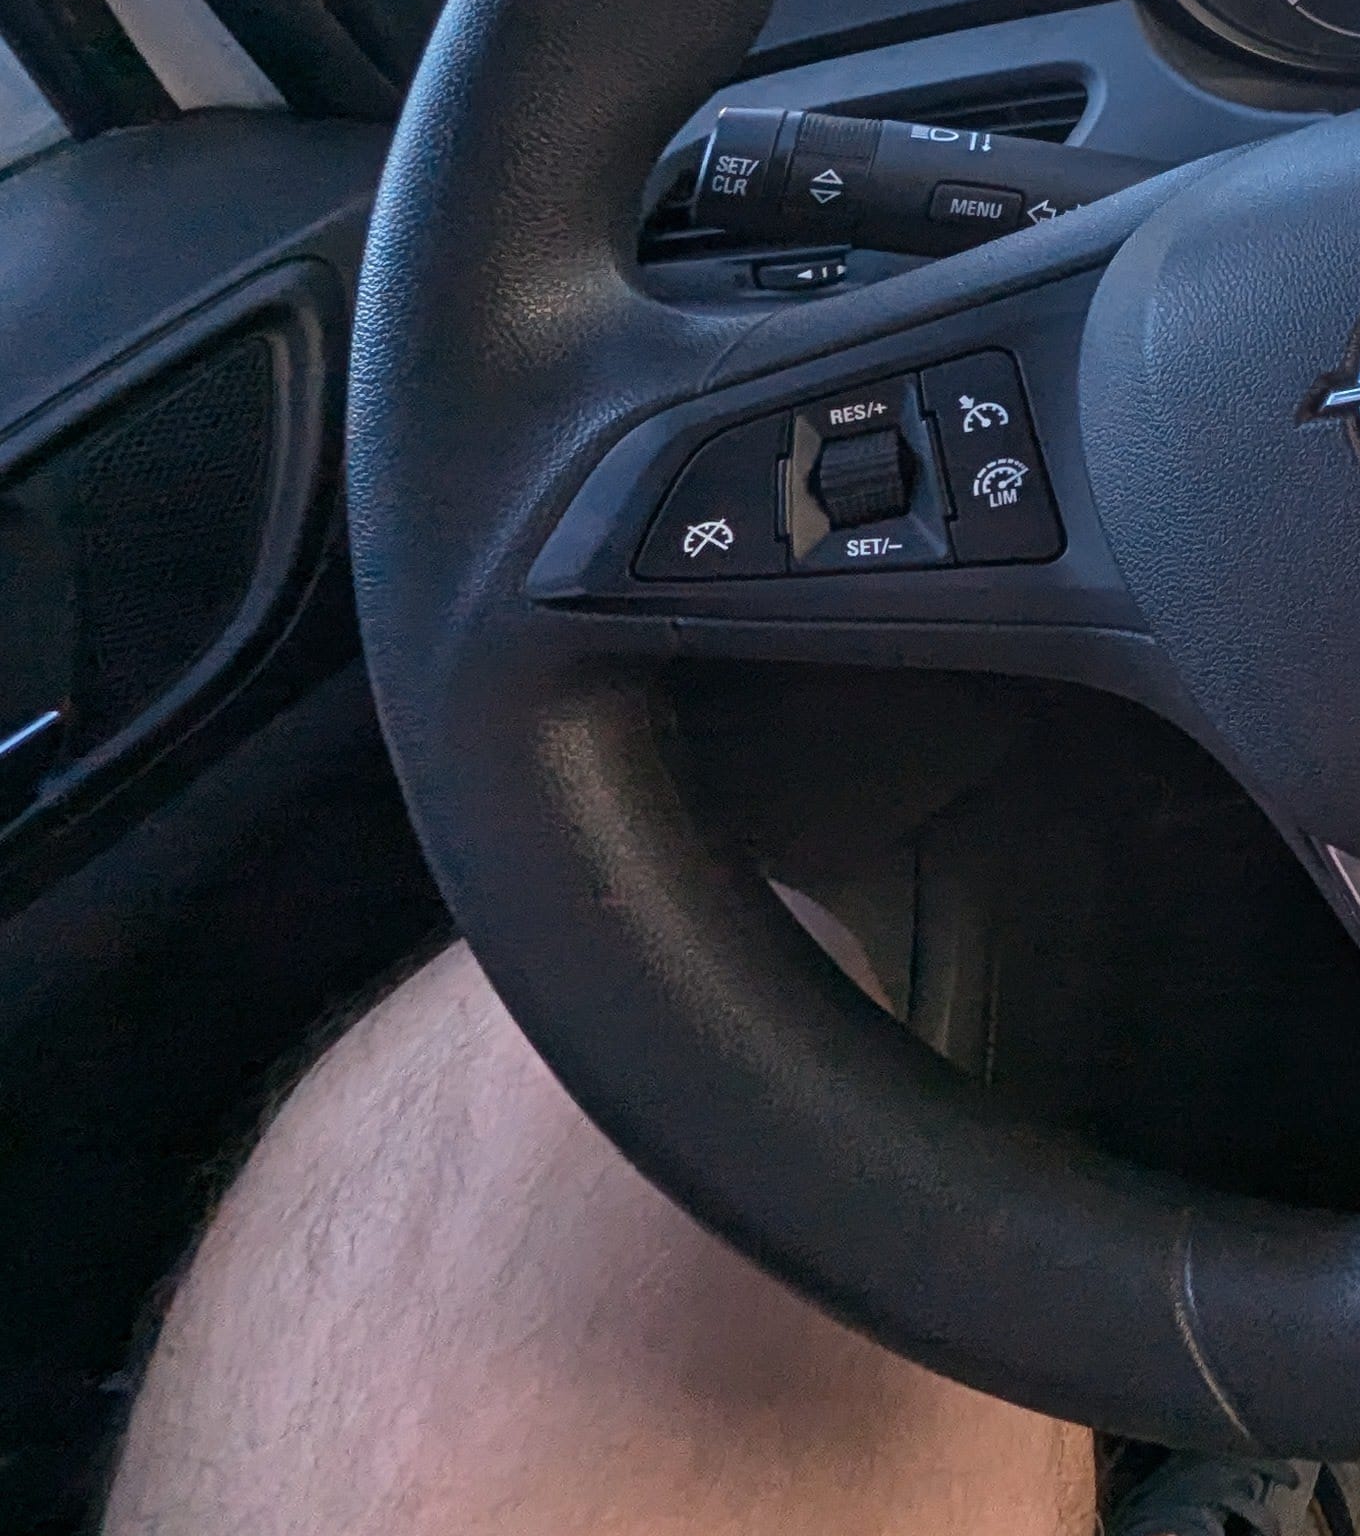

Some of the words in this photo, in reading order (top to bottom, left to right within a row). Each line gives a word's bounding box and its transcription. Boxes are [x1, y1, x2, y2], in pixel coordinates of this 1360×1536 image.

[717, 155, 759, 177] SET/
[711, 174, 747, 196] CLR
[949, 198, 1003, 220] MENU
[989, 489, 1018, 508] LIM
